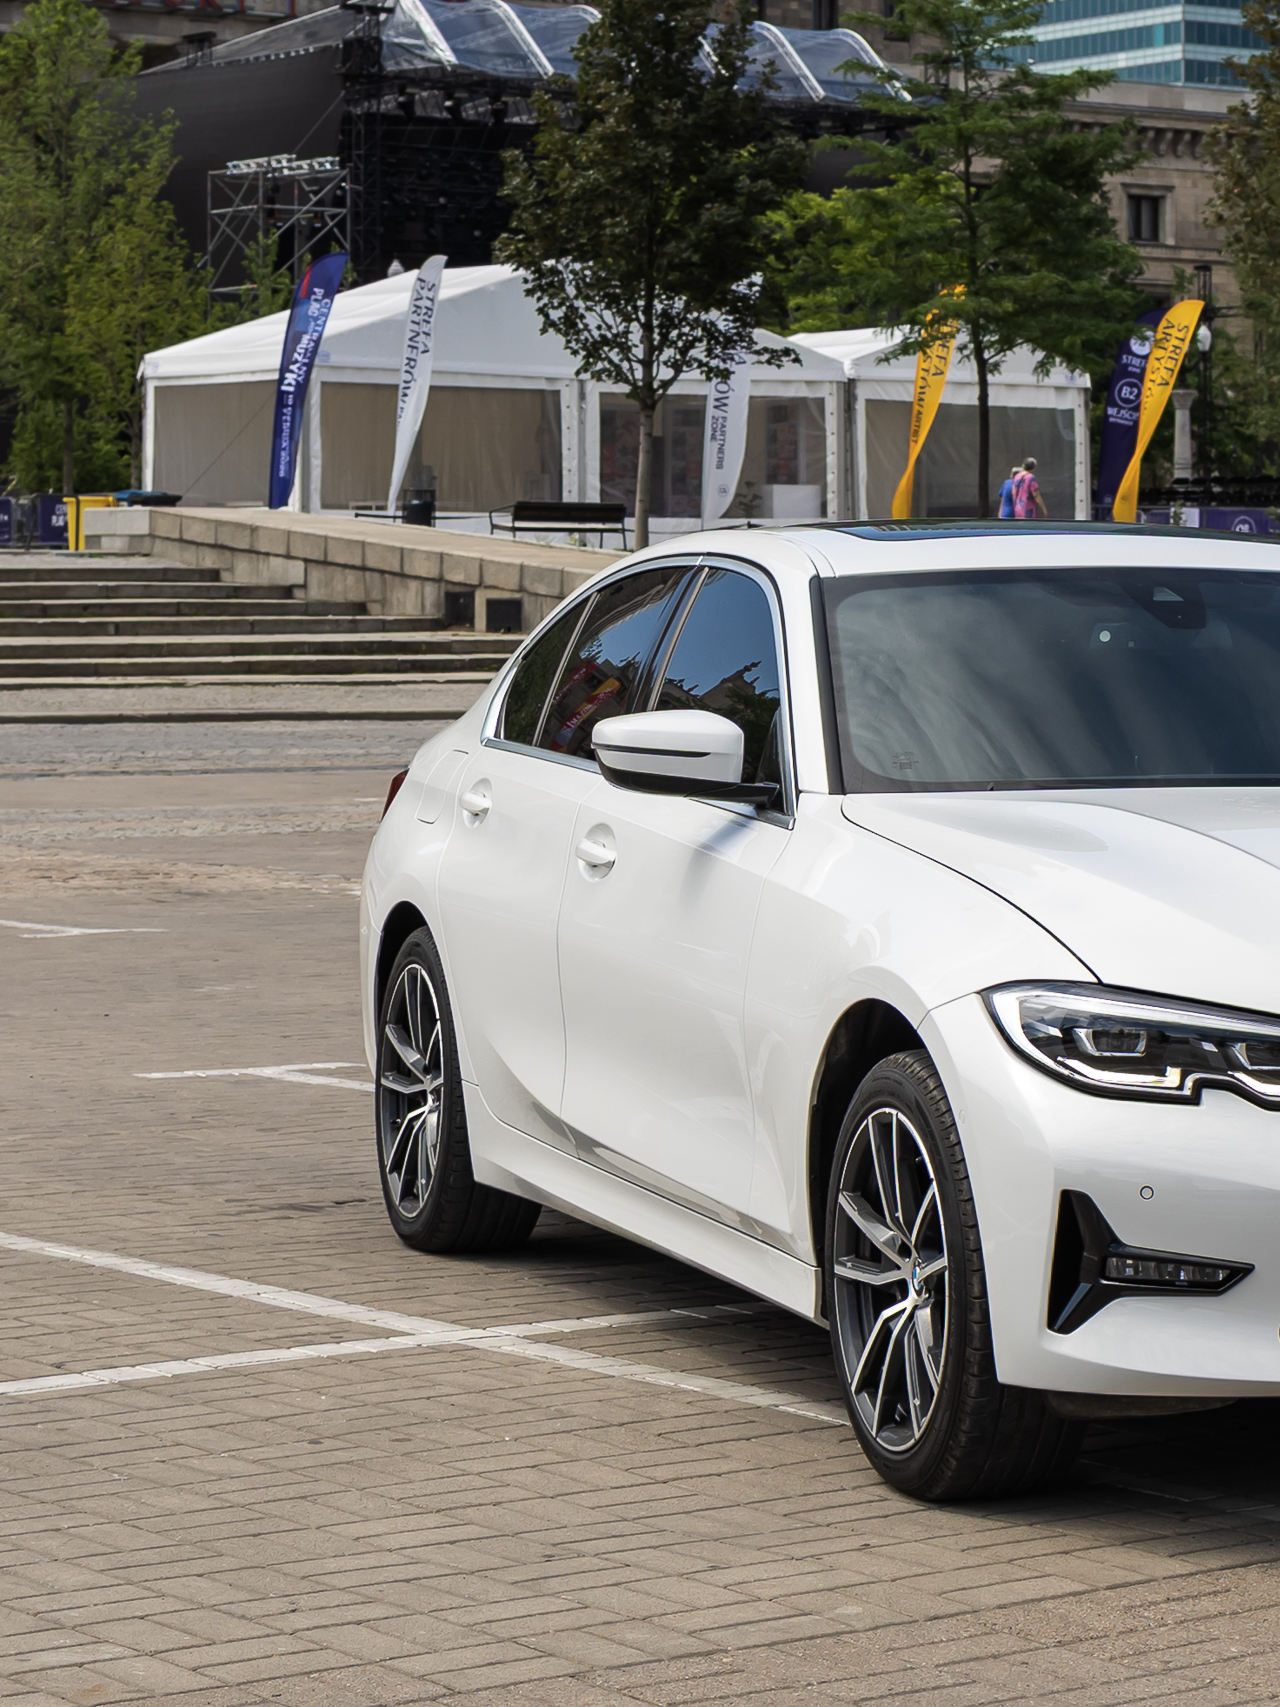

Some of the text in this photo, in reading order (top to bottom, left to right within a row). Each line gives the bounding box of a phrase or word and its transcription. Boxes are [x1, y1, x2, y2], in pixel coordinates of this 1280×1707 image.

[419, 279, 436, 354] STREFA
[1120, 353, 1148, 367] STREF
[1157, 321, 1190, 387] STREFA
[1121, 385, 1138, 400] B2
[710, 415, 719, 443] ZONE
[715, 415, 728, 470] PARTNERS
